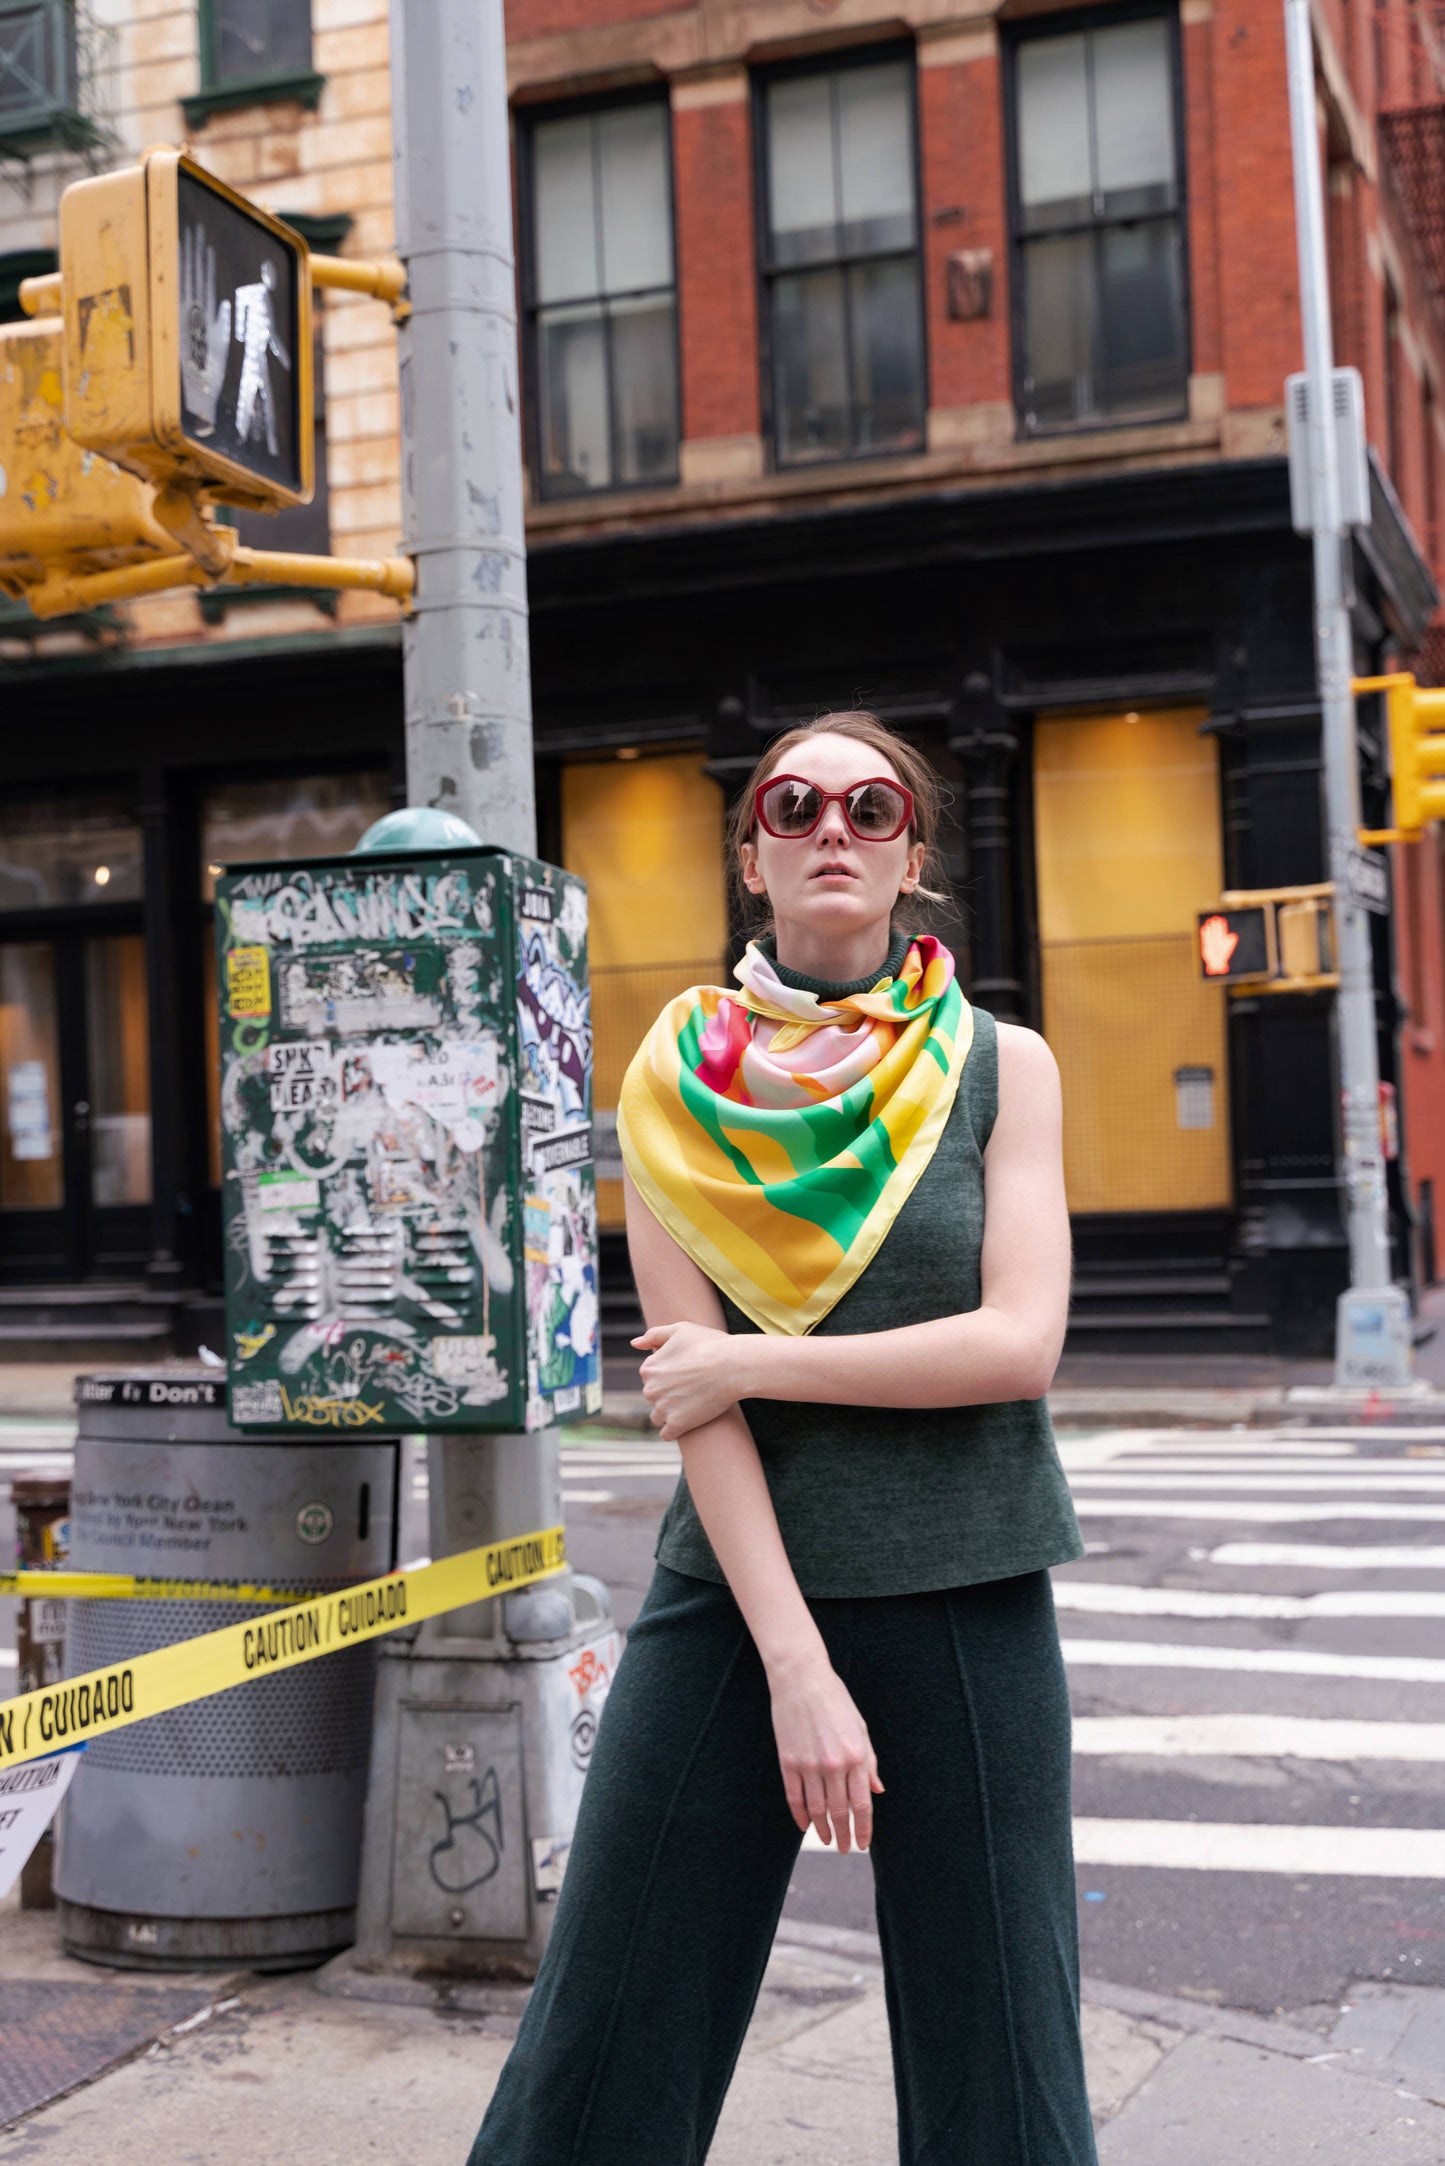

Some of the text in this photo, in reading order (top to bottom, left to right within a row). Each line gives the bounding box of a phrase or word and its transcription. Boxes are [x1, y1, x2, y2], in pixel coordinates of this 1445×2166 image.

[150, 1382, 216, 1403] Don't
[486, 1540, 545, 1587] CAUTION
[243, 1609, 320, 1670] CAUTION
[338, 1581, 408, 1636] CUIDADO
[40, 1669, 134, 1742] CUIDADO
